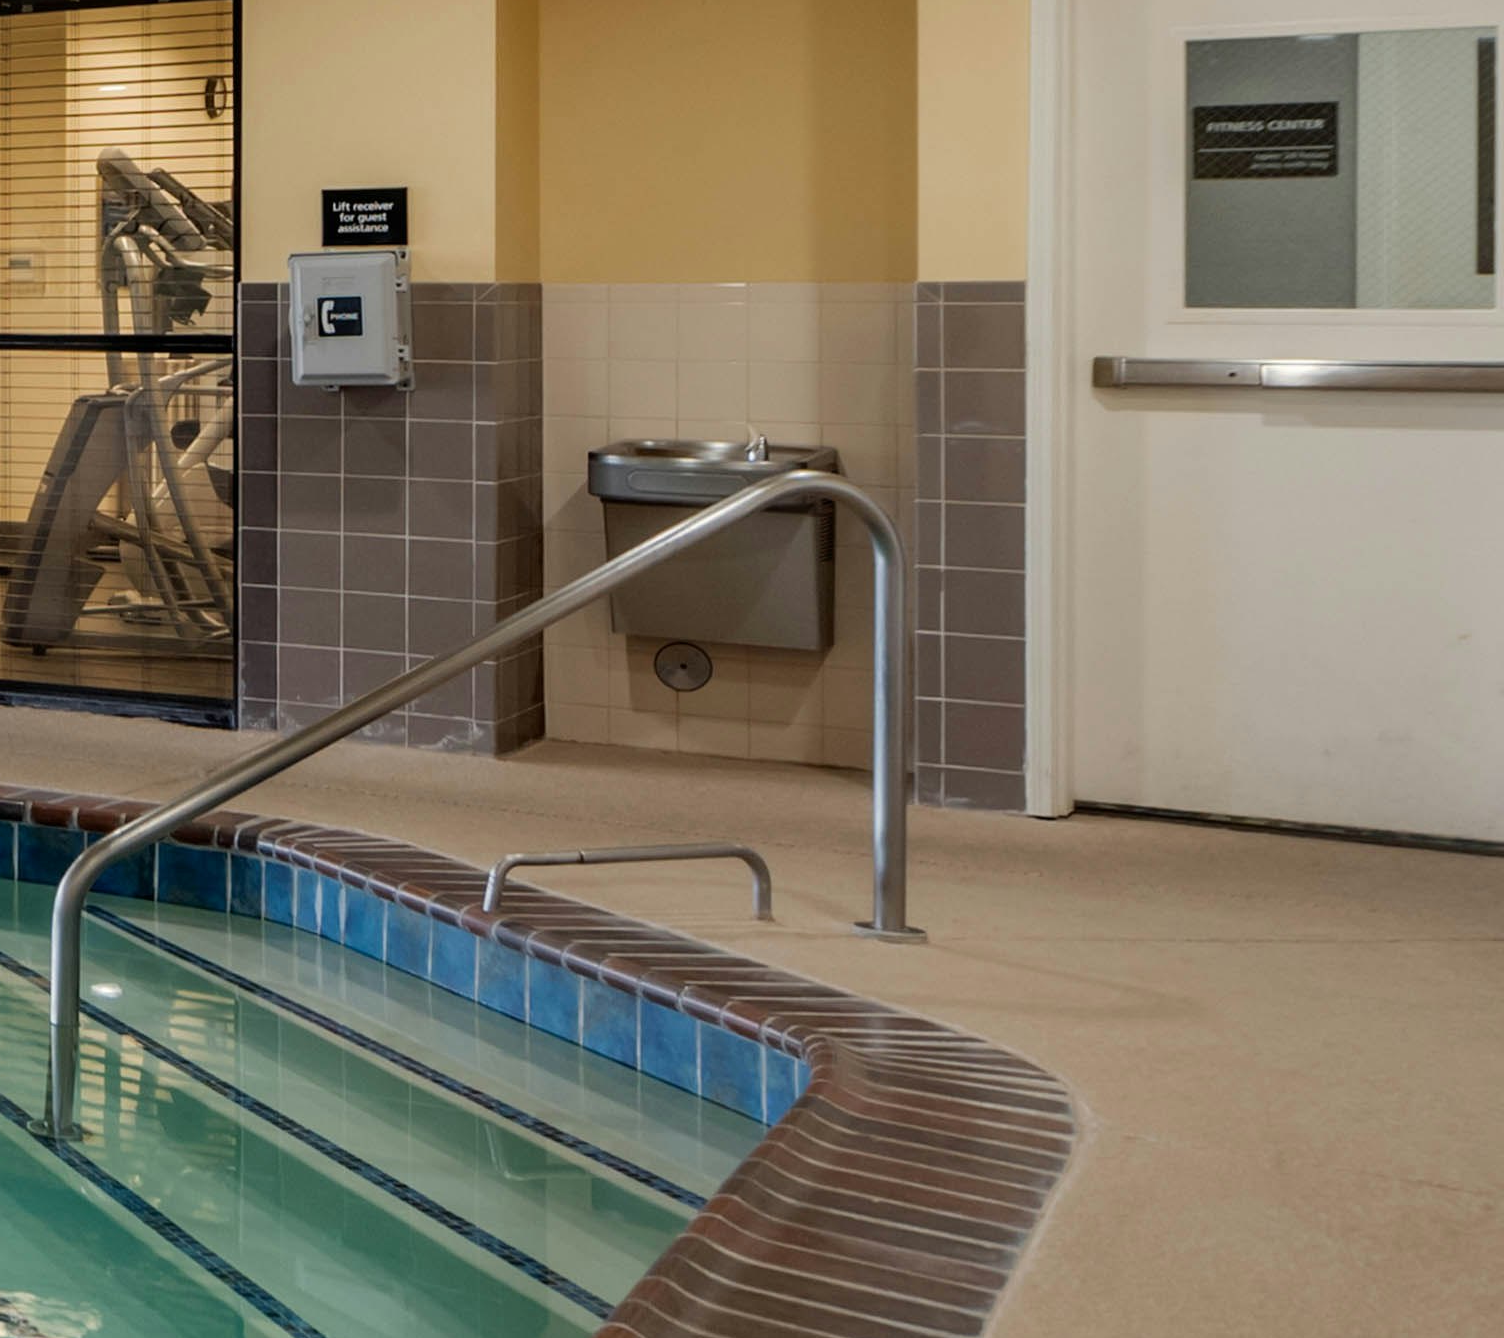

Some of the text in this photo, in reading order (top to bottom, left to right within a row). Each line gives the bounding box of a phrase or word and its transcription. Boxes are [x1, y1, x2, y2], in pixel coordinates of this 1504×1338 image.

[1206, 119, 1326, 133] FITNESS CENTER
[333, 201, 394, 212] Lift receiver
[339, 212, 387, 224] for guest
[338, 223, 389, 233] assistance
